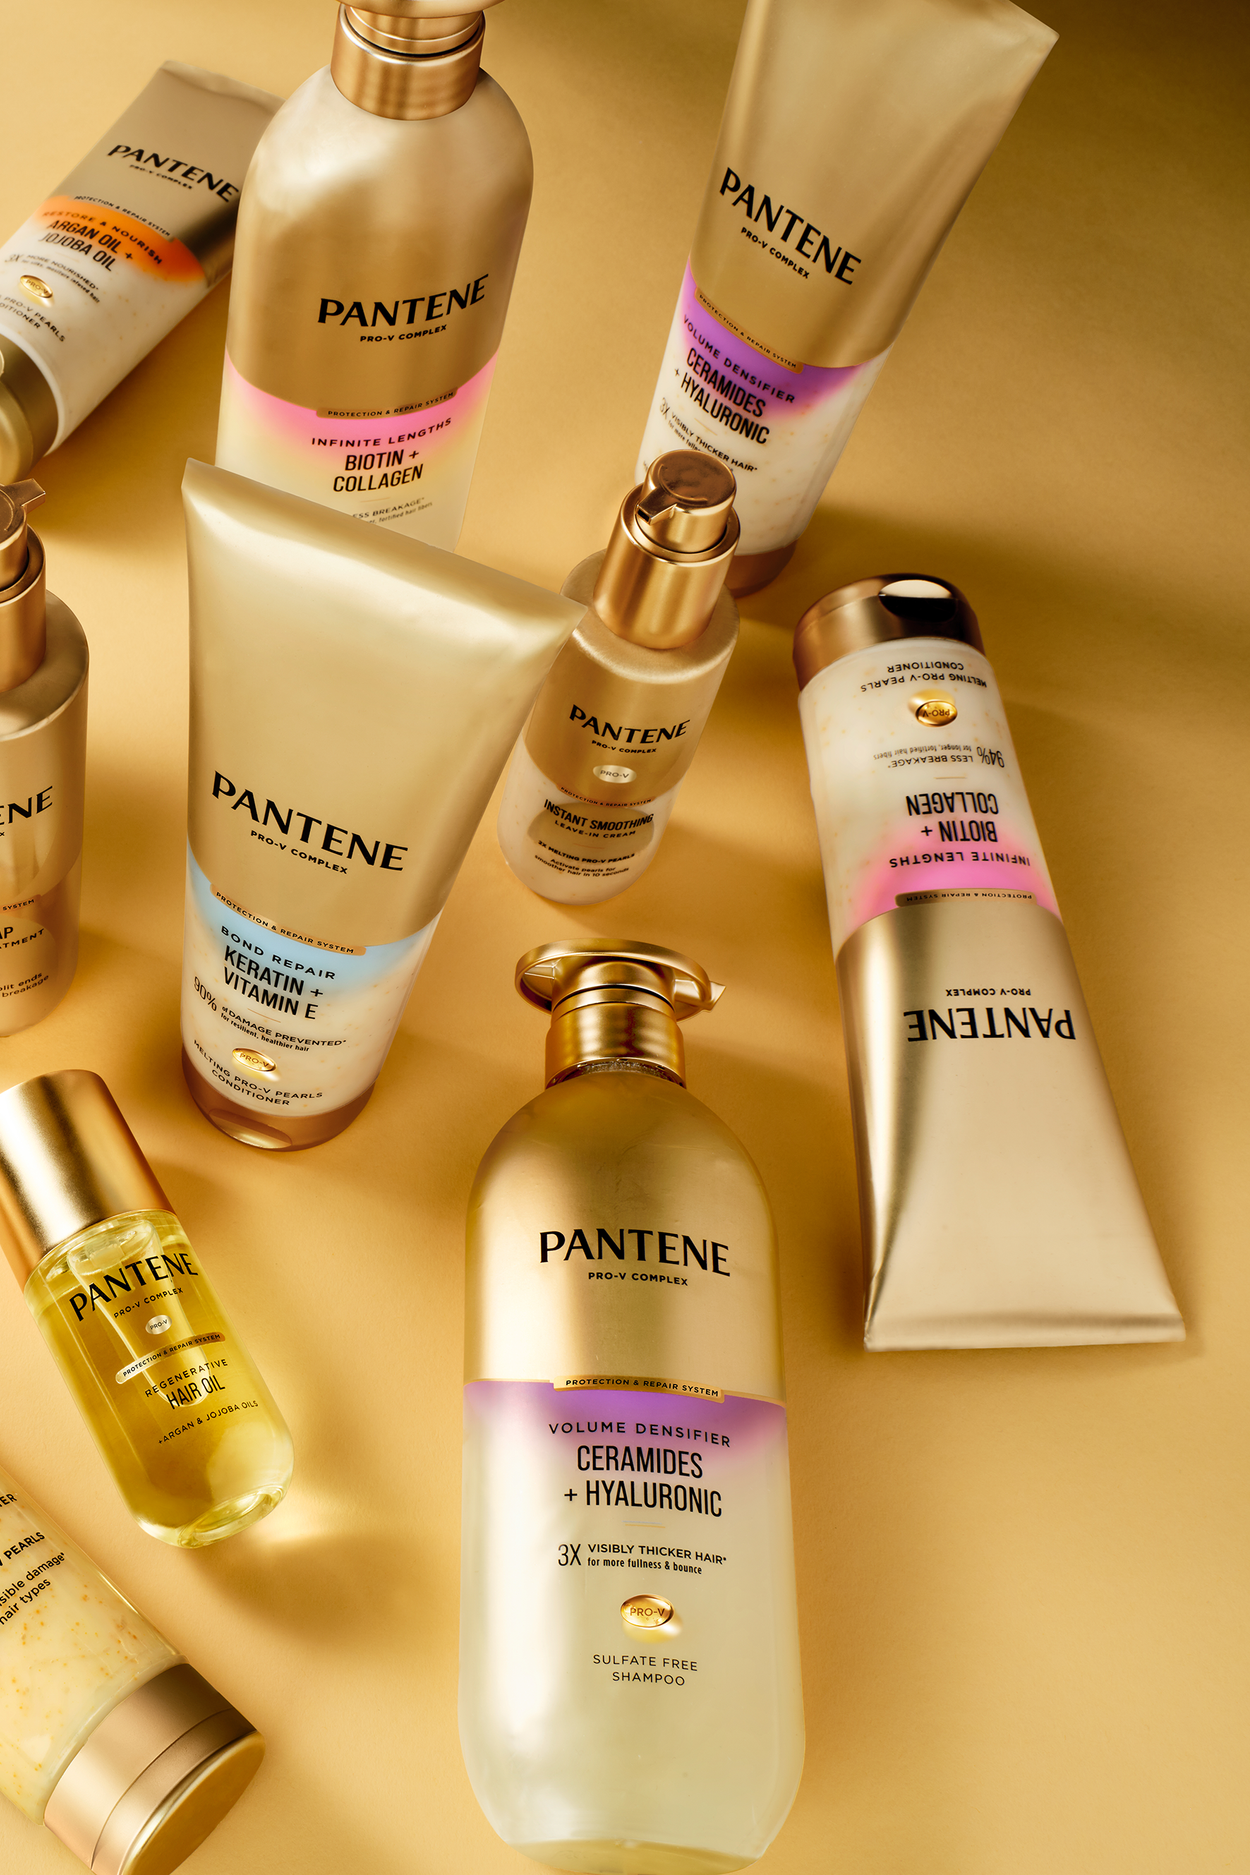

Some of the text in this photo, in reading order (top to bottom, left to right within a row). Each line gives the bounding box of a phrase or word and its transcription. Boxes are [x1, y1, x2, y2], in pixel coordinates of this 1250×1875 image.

[108, 144, 239, 202] PANTENE
[48, 220, 134, 260] ARGAN OIL +
[720, 167, 862, 285] PANTENE
[39, 233, 119, 271] JOJOBA OIL
[318, 274, 489, 327] PANTENE
[684, 314, 795, 403] VOLUME DENSIFIER
[686, 348, 766, 418] CERAMIDES
[681, 373, 770, 444] HYALURONIC
[312, 418, 451, 447] INFINITE LENGTHS
[345, 450, 419, 471] BIOTIN +
[333, 464, 423, 492] COLLAGEN
[887, 662, 964, 673] CONDITIONER
[569, 704, 690, 744] PANTENE
[600, 770, 629, 778] PRO-V
[211, 770, 408, 872] PANTENE
[544, 799, 654, 831] INSTANT SMOOTHING
[906, 792, 999, 816] COLLAGEN
[555, 820, 636, 839] LEAVE-IN CREAM
[921, 820, 998, 842] BIOTIN +
[250, 830, 348, 874] PRO-V COMPLEX
[889, 852, 1030, 868] INFINITE LENGTHS
[221, 926, 336, 980] BOND REPAIR
[224, 945, 323, 997] KERATIN +
[224, 966, 319, 1020] VITAMIN E
[903, 1007, 1076, 1042] PANTENE
[211, 1069, 290, 1106] CONDITIONER
[540, 1228, 731, 1277] PANTENE
[69, 1253, 198, 1322] PANTENE
[588, 1272, 689, 1286] PRO-V COMPLEX
[114, 1287, 183, 1318] PRO-V COMPLEX
[145, 1359, 228, 1397] REGENERATIVE
[167, 1375, 226, 1409] HAIR OIL
[159, 1421, 194, 1444] +ARGAN
[207, 1404, 239, 1421] JOJOBA
[242, 1400, 258, 1409] OILS
[549, 1421, 731, 1448] VOLUME DENSIFIER
[577, 1445, 703, 1479] CERAMIDES
[564, 1480, 722, 1517] + HYALURONIC
[3, 1532, 45, 1559] PEARLS
[558, 1543, 582, 1567] 3X
[588, 1544, 635, 1555] VISIBLY
[638, 1545, 692, 1560] THICKER
[588, 1557, 702, 1575] for more fullness & bounce
[20, 1578, 51, 1609] types
[630, 1606, 665, 1618] PRO-V
[593, 1654, 698, 1671] SULFATE FREE
[612, 1672, 685, 1686] SHAMPOO
